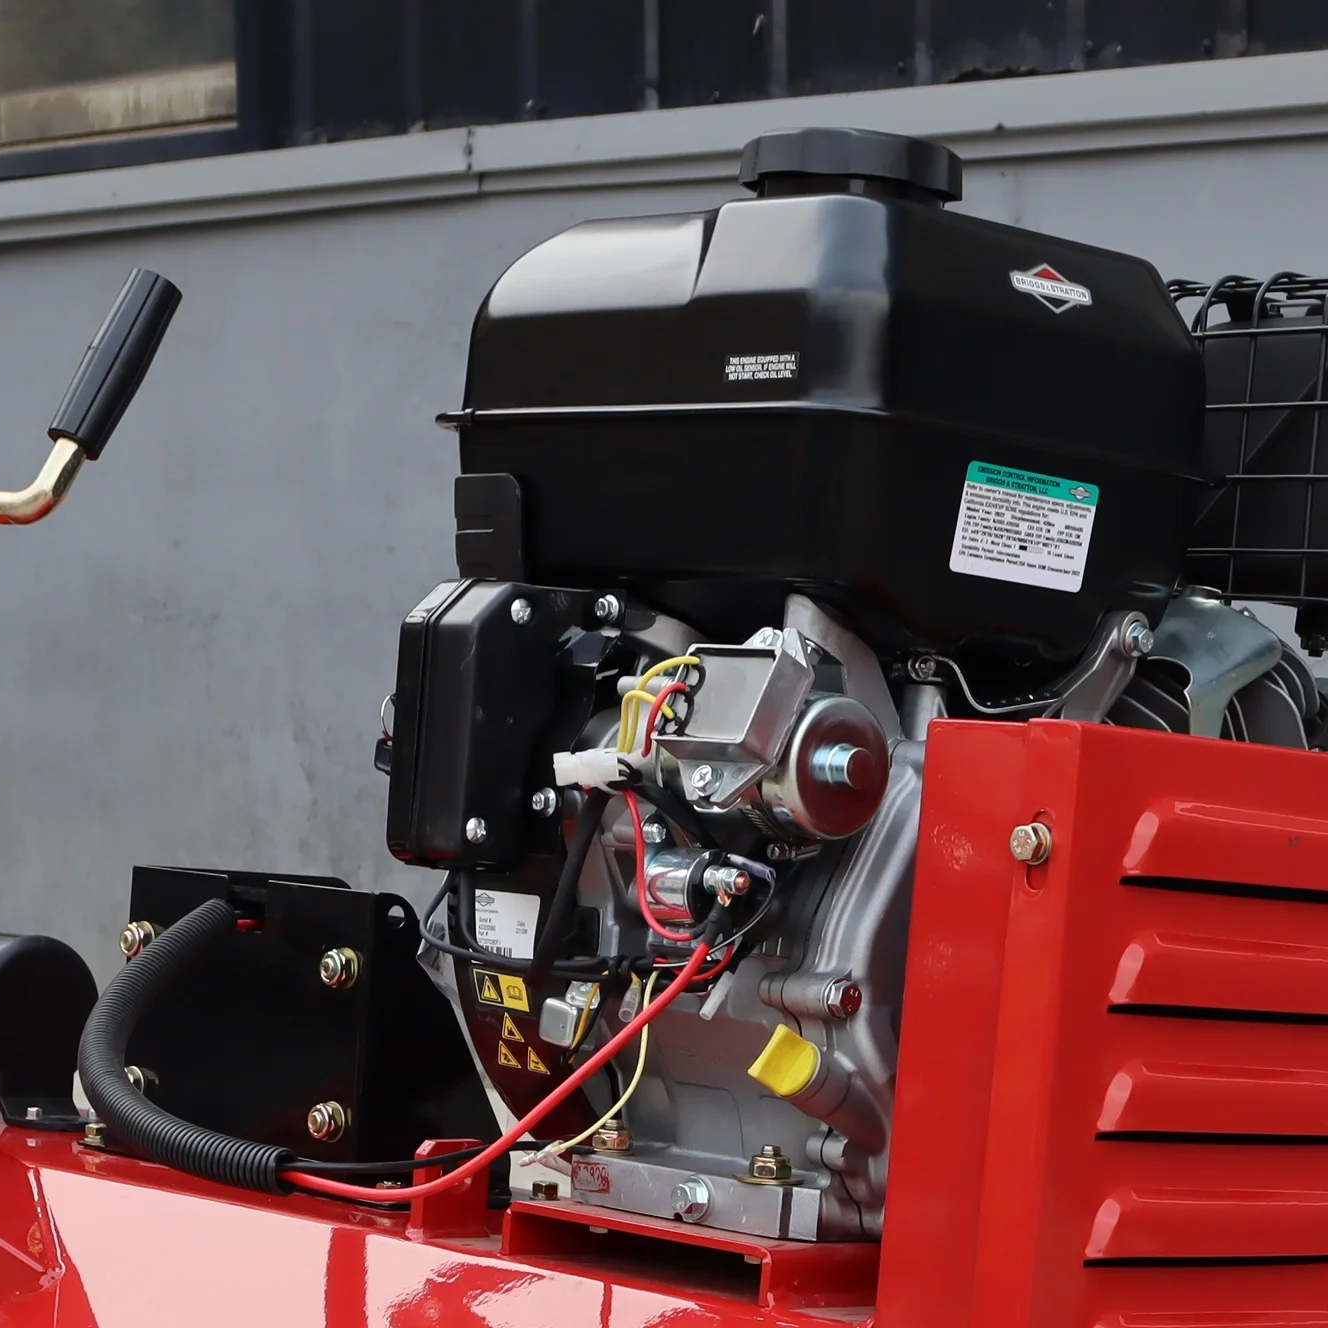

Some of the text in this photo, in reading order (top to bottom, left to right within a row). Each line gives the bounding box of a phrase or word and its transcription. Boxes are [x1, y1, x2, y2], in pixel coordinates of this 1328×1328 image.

[740, 356, 756, 364] ENGINE
[757, 355, 779, 364] EQUIPPED
[725, 365, 735, 373] LOW
[785, 362, 796, 370] WILL
[754, 371, 769, 379] CHECK
[1002, 471, 1026, 480] CONTROL
[1027, 476, 1061, 488] INFORMATION
